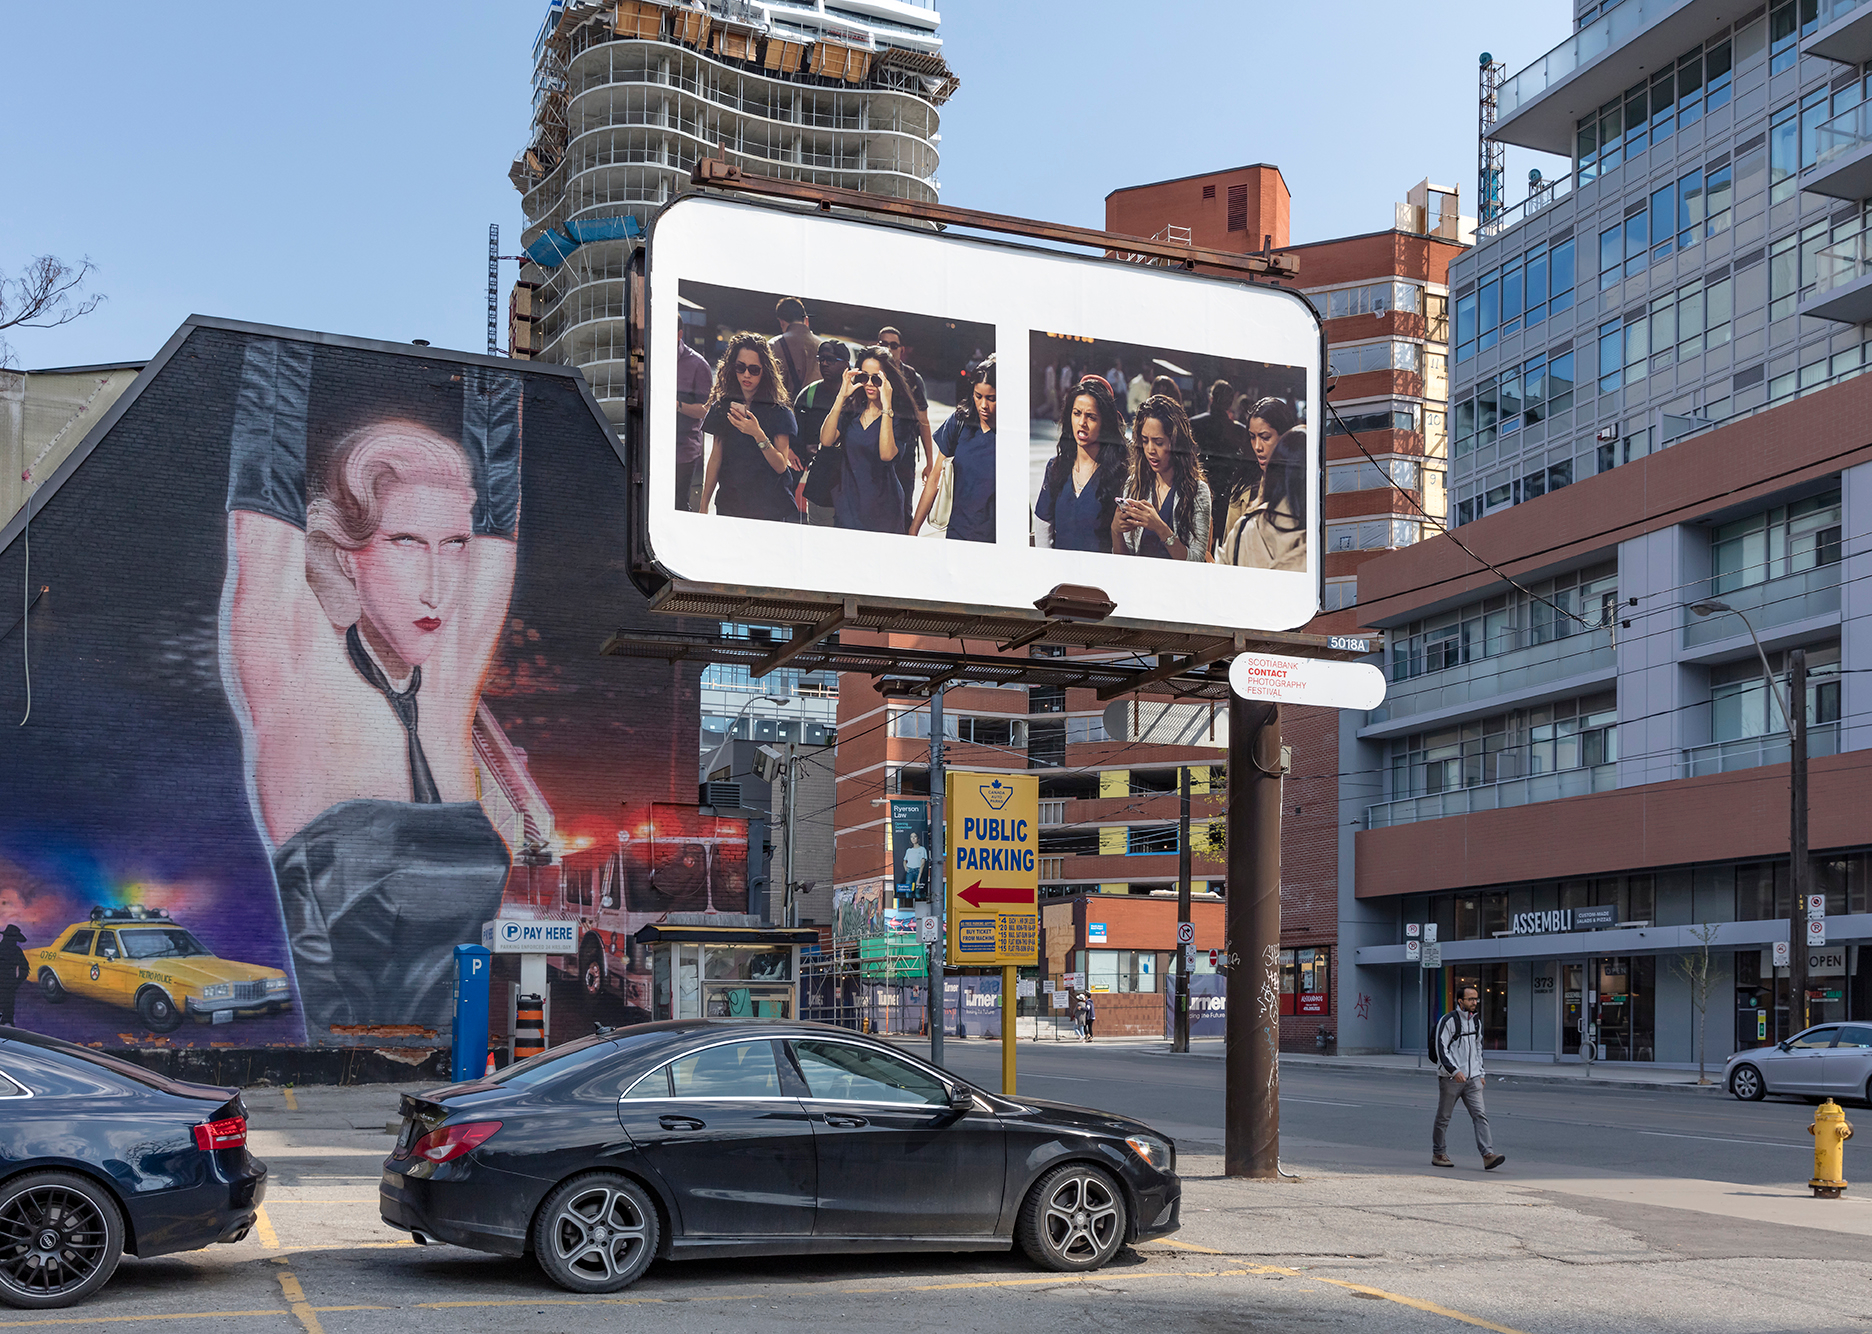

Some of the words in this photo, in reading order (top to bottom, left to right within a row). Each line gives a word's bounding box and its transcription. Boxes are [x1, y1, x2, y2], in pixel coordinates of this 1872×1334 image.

[1427, 413, 1441, 426] 10
[1430, 473, 1437, 486] 9
[1330, 637, 1365, 651] 5018A
[1247, 658, 1299, 670] SCOTIABANK
[1247, 667, 1288, 678] CONTACT
[1247, 677, 1307, 689] PHOTOGRAPHY
[1247, 686, 1282, 697] FESTIVAL
[893, 805, 920, 813] Ryerson
[964, 817, 1028, 842] PUBLIC
[956, 846, 1035, 872] PARKING
[1512, 909, 1572, 934] ASSEMBLI
[524, 926, 543, 940] PAY
[546, 926, 573, 940] HERE
[40, 950, 57, 960] 0769
[1809, 955, 1841, 968] OPEN
[472, 958, 482, 975] P
[138, 969, 155, 980] METRO
[155, 973, 173, 985] POLICE
[1534, 976, 1554, 988] 373
[944, 982, 959, 992] Turner
[877, 990, 900, 1006] Turner
[964, 989, 997, 1007] Turner
[1189, 996, 1227, 1011] urner
